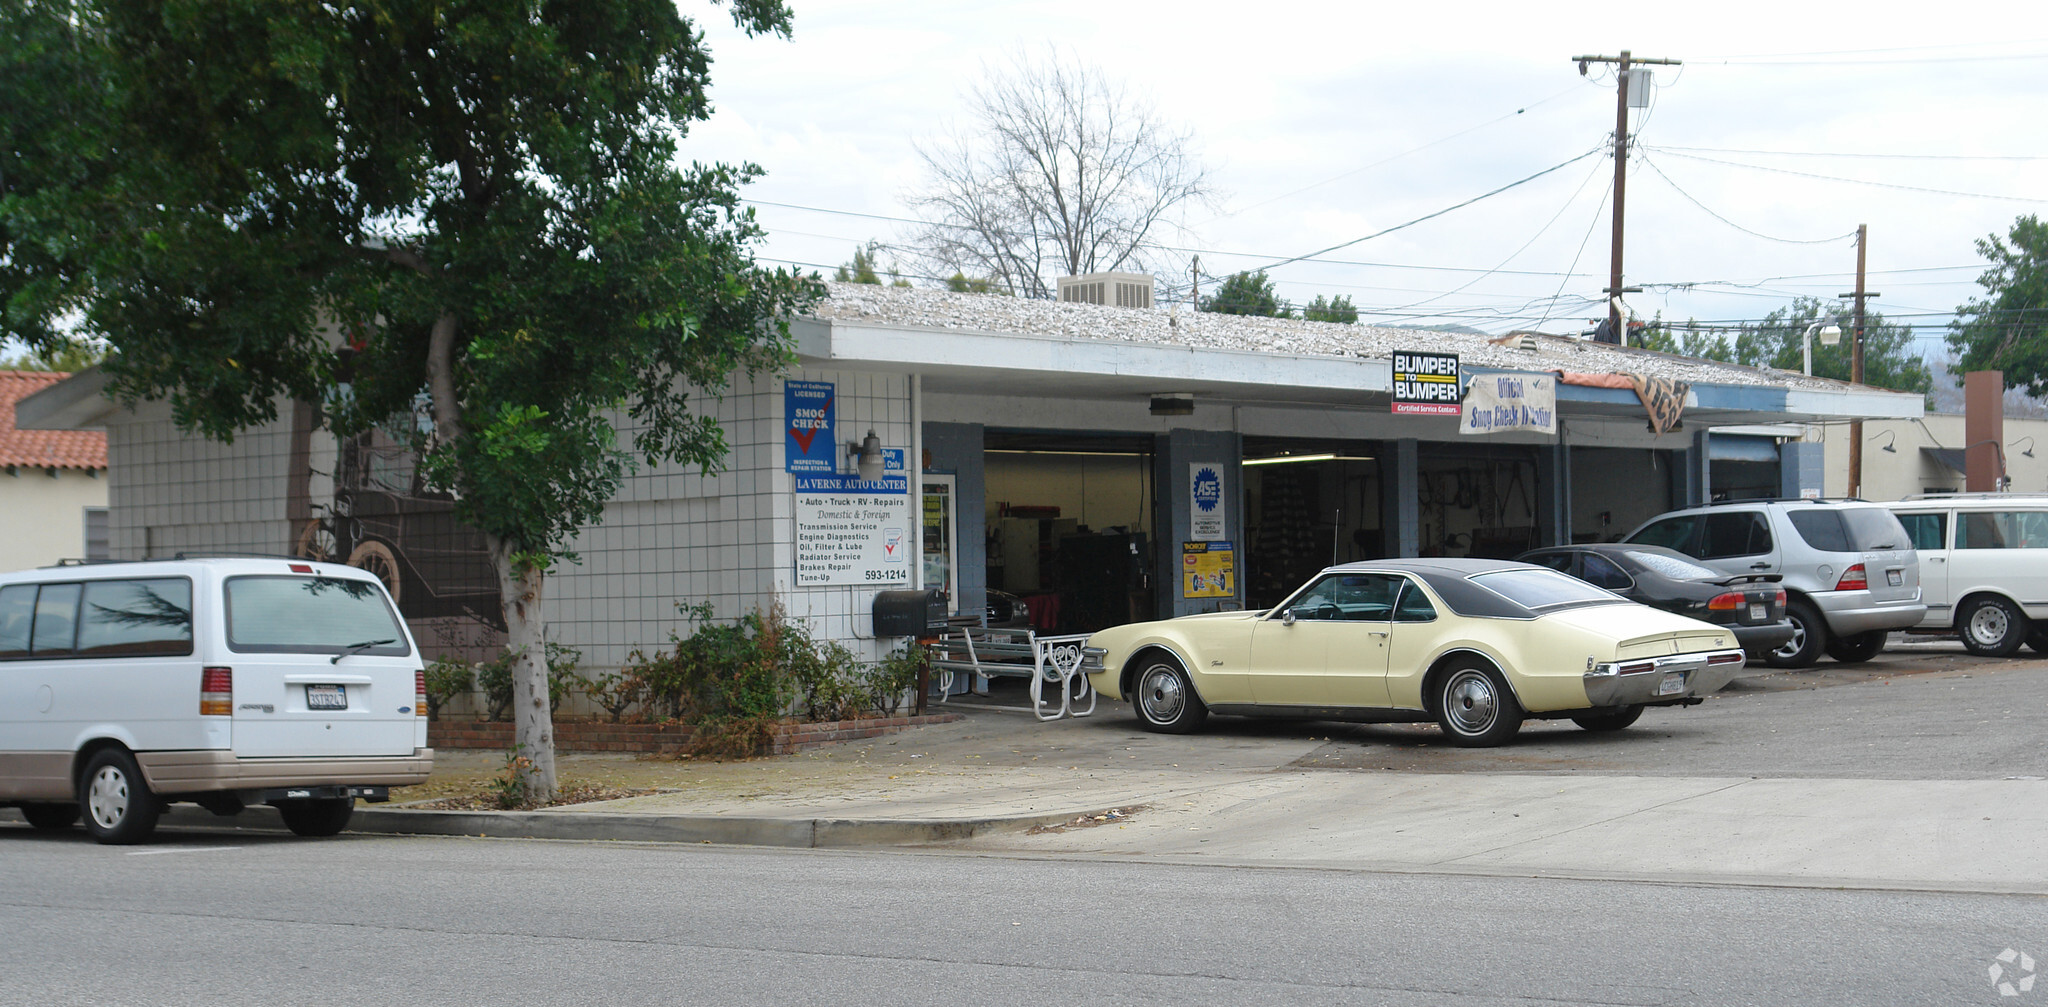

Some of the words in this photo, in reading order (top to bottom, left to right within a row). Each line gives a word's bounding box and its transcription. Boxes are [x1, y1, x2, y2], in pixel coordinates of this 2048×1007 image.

[1395, 355, 1457, 375] BUMPER
[1405, 373, 1417, 381] TO
[1395, 381, 1458, 401] BUMPER
[1497, 377, 1525, 398] Official
[795, 390, 826, 398] LICENSED
[795, 408, 825, 418] SMOG
[1397, 404, 1420, 412] Certified
[1470, 406, 1492, 431] Smog
[1494, 404, 1518, 426] Check
[792, 418, 829, 429] CHECK
[882, 450, 896, 459] Duty
[887, 460, 901, 470] Only
[797, 479, 810, 489] LA
[811, 479, 842, 489] VERNE
[845, 479, 869, 490] AUTO
[871, 480, 906, 490] CENTER
[1197, 481, 1216, 496] ASE
[805, 498, 823, 506] Auto
[830, 498, 851, 506] Truck
[873, 498, 905, 506] Repairs
[817, 510, 852, 519] Domestic
[854, 510, 860, 518] &
[861, 510, 891, 521] Foreign
[799, 533, 825, 541] Engine
[827, 533, 870, 541] Diagnostics
[799, 543, 813, 551] Oil,
[799, 553, 831, 561] Radiator
[799, 563, 825, 571] Brakes
[828, 563, 852, 572] Repair
[800, 573, 831, 581] Tune-Up
[865, 569, 907, 580] 593-1214
